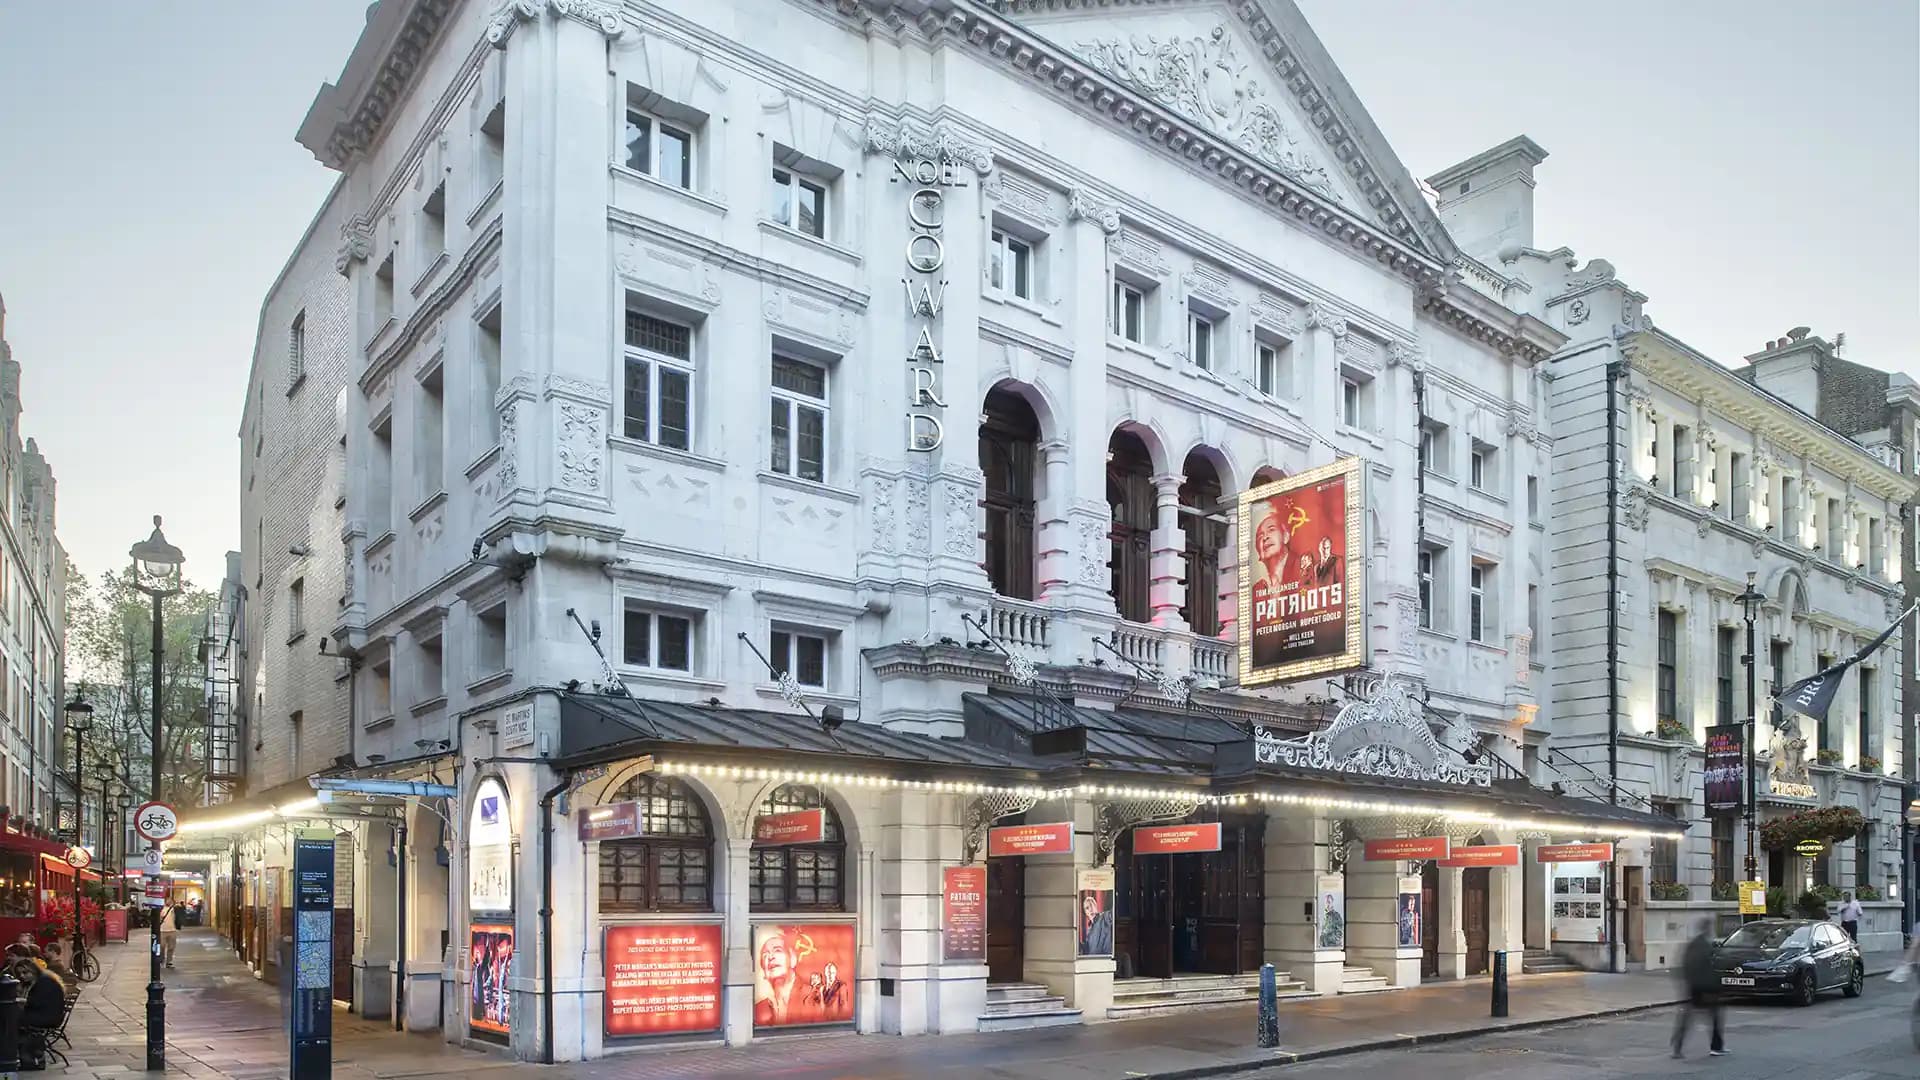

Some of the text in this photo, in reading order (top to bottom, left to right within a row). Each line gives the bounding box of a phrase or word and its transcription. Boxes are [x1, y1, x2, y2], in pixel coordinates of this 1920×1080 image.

[901, 189, 949, 453] COWARD
[1301, 615, 1321, 627] RUPERT
[1322, 610, 1342, 623] GOOLD
[1256, 625, 1272, 636] PETER
[1273, 620, 1297, 633] MORGAN
[1301, 630, 1315, 639] KEEN
